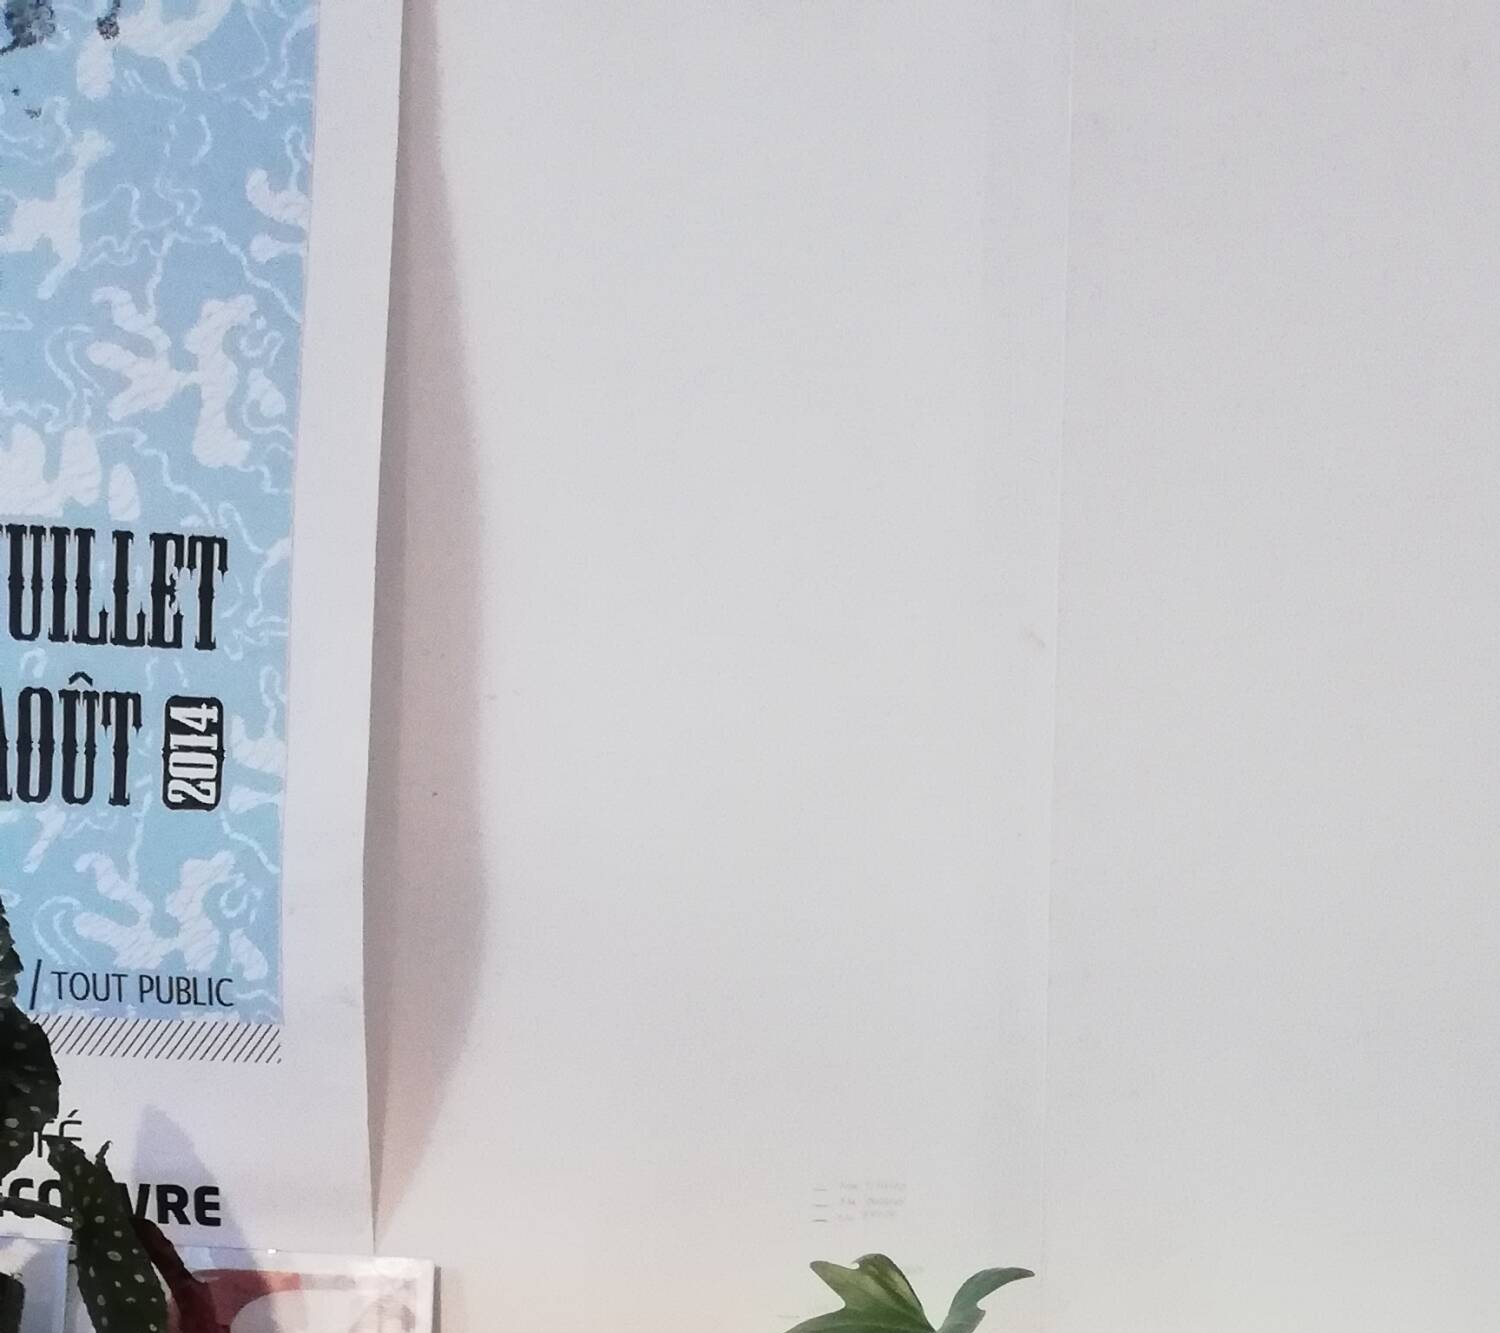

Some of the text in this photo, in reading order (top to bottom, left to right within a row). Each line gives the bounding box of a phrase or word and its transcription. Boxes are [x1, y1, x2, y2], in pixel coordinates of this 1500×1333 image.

[0, 524, 228, 650] UILLET
[167, 702, 219, 805] 2014
[51, 971, 128, 1002] TOUT
[139, 974, 234, 1007] PUBLIC
